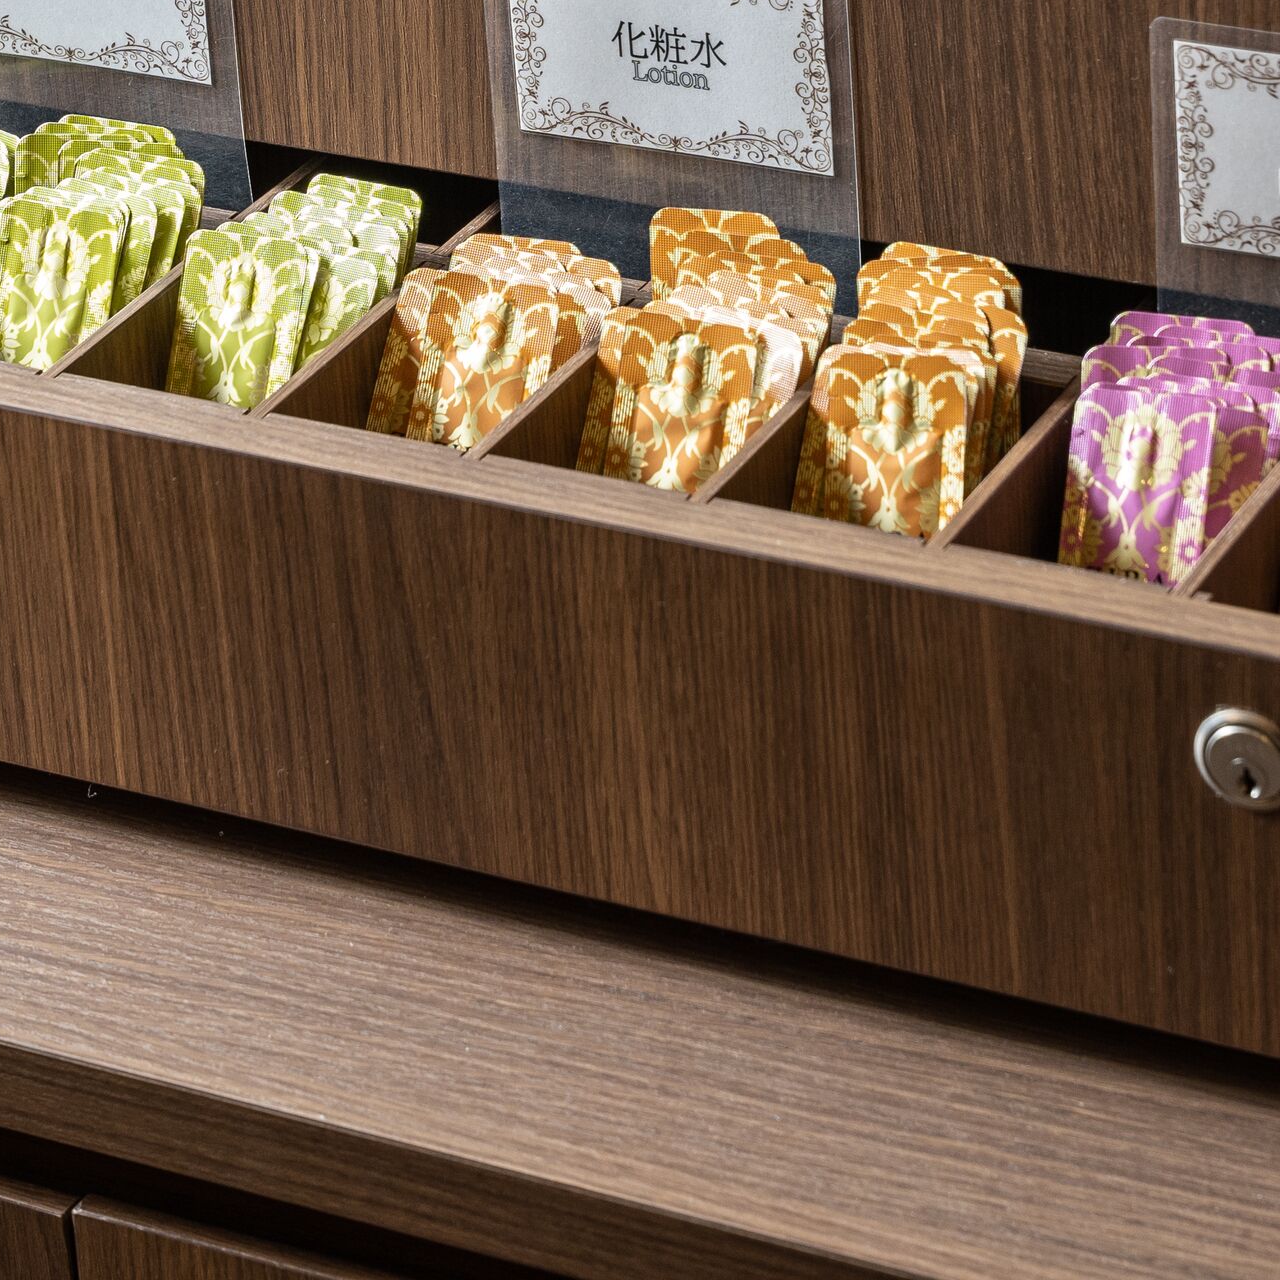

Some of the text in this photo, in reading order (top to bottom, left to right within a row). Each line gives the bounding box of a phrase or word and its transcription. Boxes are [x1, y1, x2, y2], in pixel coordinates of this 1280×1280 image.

[611, 20, 727, 68] 化粧水
[631, 59, 711, 91] Lotion
